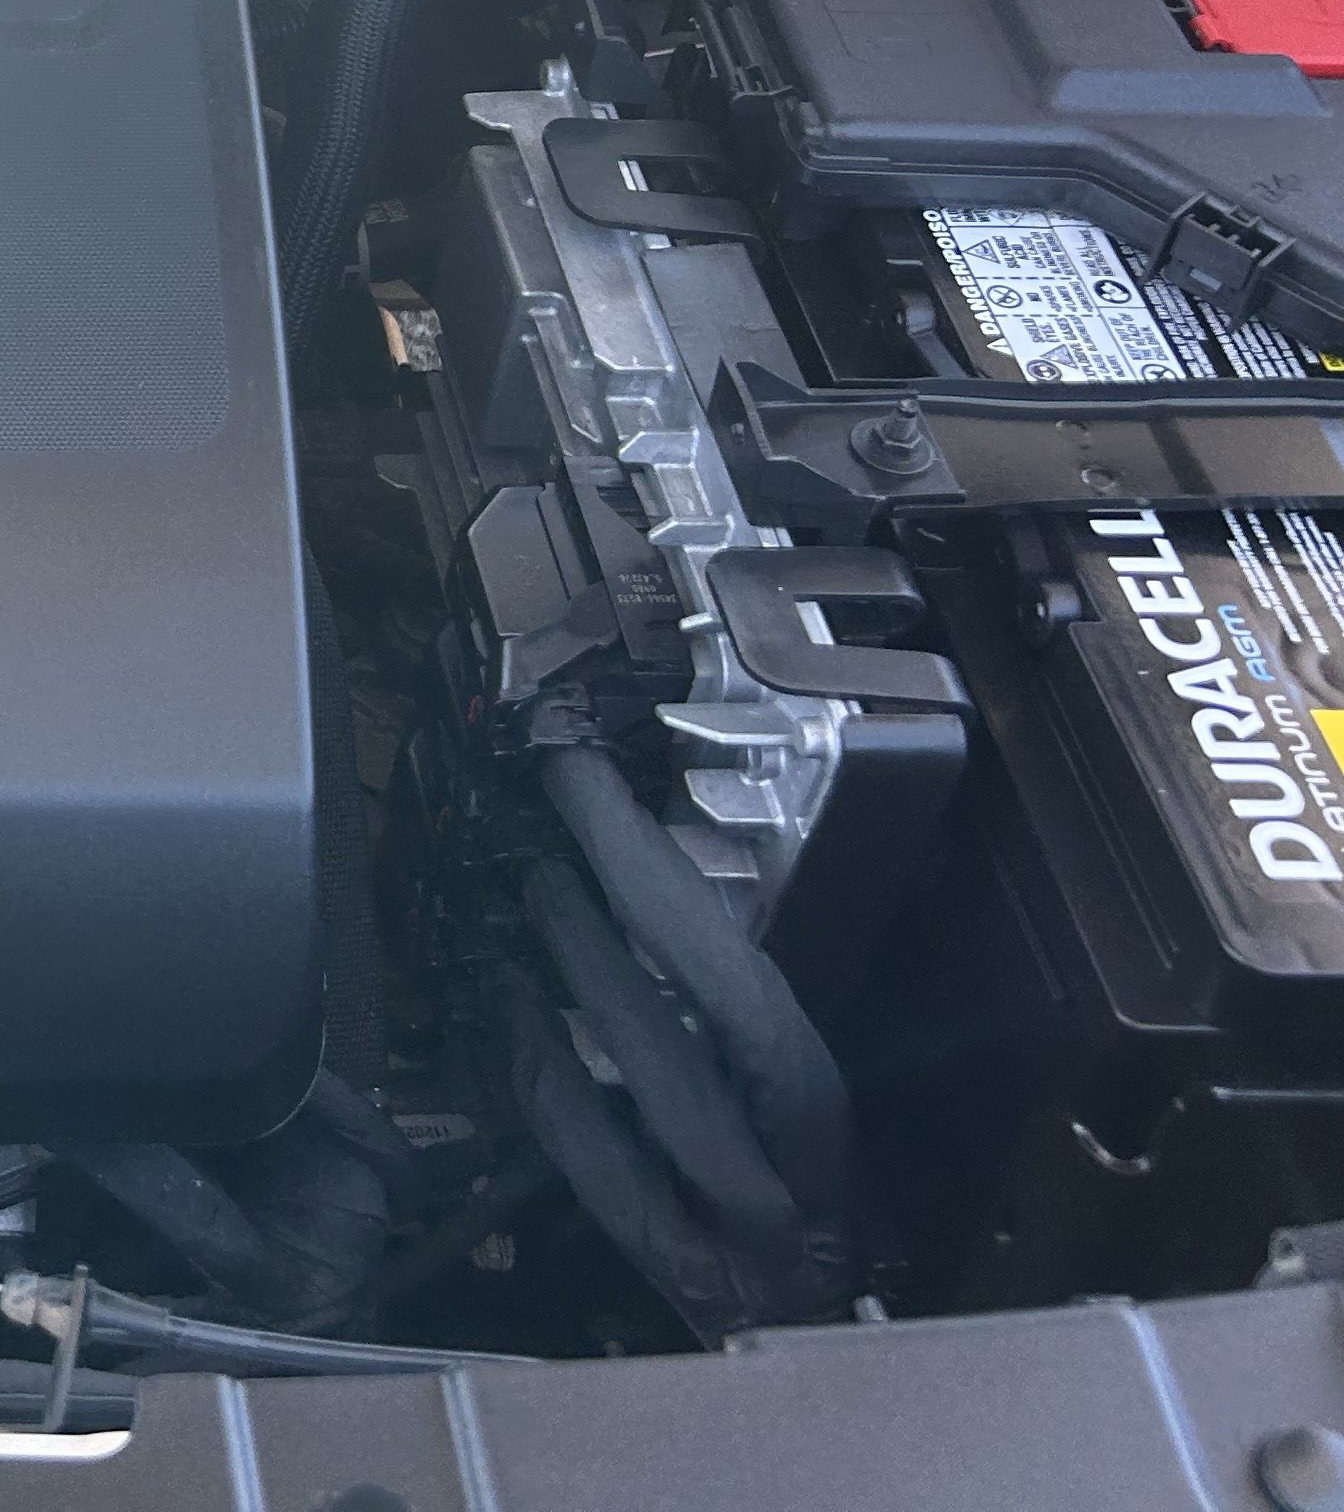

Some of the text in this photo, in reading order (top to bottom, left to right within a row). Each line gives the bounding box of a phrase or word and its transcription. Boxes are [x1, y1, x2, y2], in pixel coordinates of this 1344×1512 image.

[922, 209, 1001, 334] DANGER/POISO
[1089, 508, 1343, 881] DURACELL
[1218, 604, 1276, 682] AGM
[1265, 694, 1344, 832] ATINUM
